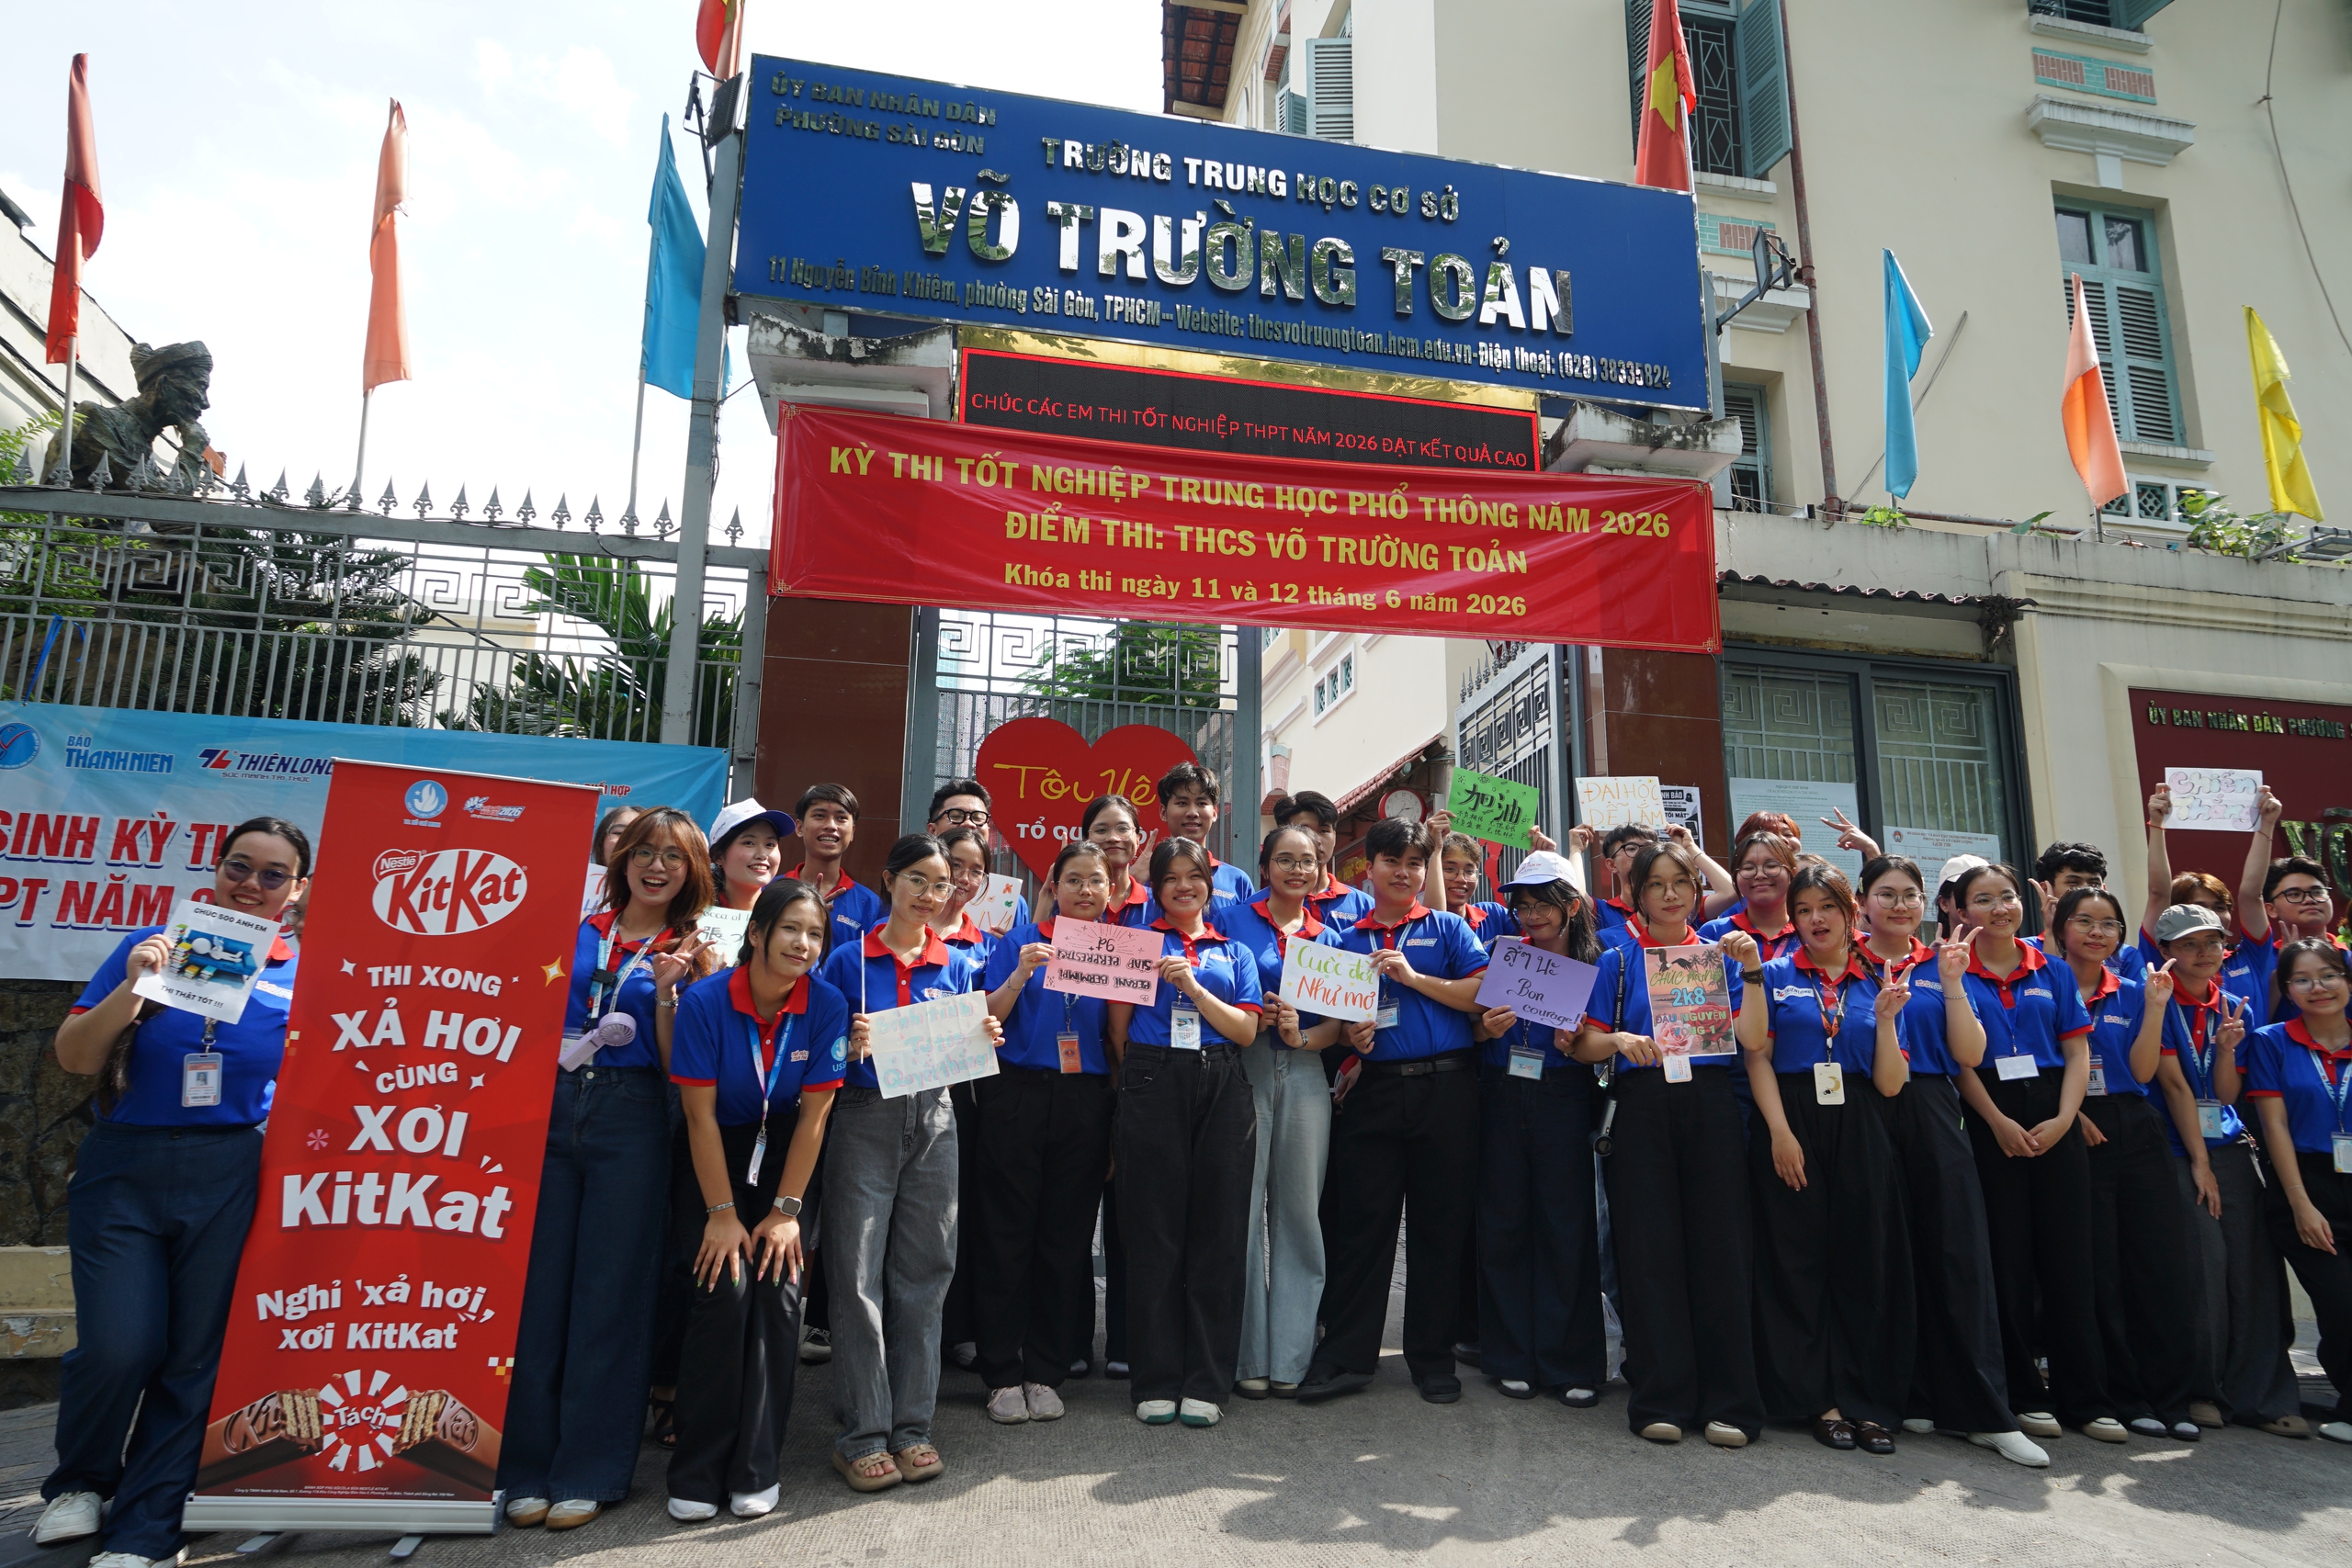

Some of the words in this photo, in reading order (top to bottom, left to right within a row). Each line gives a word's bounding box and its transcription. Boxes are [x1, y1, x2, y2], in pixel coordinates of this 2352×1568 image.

[771, 70, 806, 97] ỦY
[811, 82, 864, 107] BAN
[869, 92, 940, 118] NHÂN
[945, 100, 997, 127] DÂN
[775, 107, 880, 141] PHƯỜNG
[886, 121, 928, 147] SÀI
[933, 129, 985, 155] GÒN
[1042, 137, 1171, 182] TRƯỜNG
[1183, 157, 1287, 198] TRUNG
[1296, 173, 1360, 211] HỌC
[1369, 183, 1410, 215] CƠ
[1420, 184, 1460, 221] SỞ
[910, 168, 1020, 262] VÕ
[1046, 198, 1356, 307] TRƯỜNG
[1381, 236, 1575, 336] TOẢN
[769, 254, 786, 284] 11
[790, 257, 855, 292] Nguyễn
[860, 265, 898, 296] Bỉnh
[902, 271, 961, 307] Khiêm,
[965, 278, 1028, 314] phường
[1032, 286, 1058, 315] Sài
[1064, 289, 1100, 322] Gòn,
[1514, 346, 1556, 379] thoại:
[1558, 351, 1599, 382] (028)
[971, 392, 1023, 412] CHÚC
[1027, 397, 1063, 417] CÁC
[1068, 404, 1092, 421] EM
[1098, 407, 1126, 424] THI
[1172, 413, 1240, 439] NGHIỆP
[1243, 423, 1289, 441] THPT
[1293, 426, 1331, 446] NĂM
[1335, 432, 1378, 451] 2026
[1382, 436, 1417, 457] ĐẠT
[1494, 450, 1527, 468] CAO
[830, 442, 876, 476] KỲ
[888, 452, 943, 482] THI
[955, 451, 1019, 490] TỐT
[1032, 465, 1150, 503] NGHIỆP
[1159, 475, 1264, 510] TRUNG
[1276, 486, 1338, 518] HỌC
[1349, 481, 1408, 520] PHỔ
[1418, 493, 1519, 529] THÔNG
[1528, 501, 1590, 534] NĂM
[1600, 510, 1670, 538] 2026
[1004, 501, 1091, 546] ĐIỂM
[1101, 519, 1163, 550] THI:
[1174, 525, 1257, 558] THCS
[1266, 527, 1307, 561] VÕ
[1317, 534, 1438, 570] TRƯỜNG
[1447, 538, 1528, 574] TOẢN
[1004, 562, 1070, 589] Khóa
[1079, 569, 1112, 592] thi
[1121, 574, 1181, 600] ngày
[1191, 577, 1222, 600] 11
[1230, 581, 1259, 603] và
[1269, 582, 1300, 604] 12
[1307, 585, 1377, 611] tháng
[1385, 589, 1401, 609] 6
[1410, 592, 1458, 614] năm
[1466, 594, 1527, 616] 2026
[2147, 699, 2167, 726] ỦY
[2172, 707, 2203, 728] BAN
[2207, 708, 2249, 732] NHÂN
[2253, 710, 2284, 734] DÂN
[2287, 716, 2346, 739] PHƯỜNG
[67, 734, 92, 748] BÁO
[610, 784, 631, 798] HỢP
[1623, 783, 1659, 802] HỌC
[2168, 771, 2258, 795] Chiến
[1458, 783, 1523, 825] 加油
[110, 811, 177, 863] KỲ
[1016, 816, 1046, 839] TỔ
[380, 855, 417, 871] Nestlé
[55, 874, 175, 927] NĂM
[387, 850, 522, 934] KitKat
[194, 907, 218, 919] CHÚC
[219, 913, 234, 924] 500
[236, 918, 254, 929] ANH
[254, 922, 267, 933] EM
[1297, 945, 1343, 979] Cuộc
[1649, 970, 1685, 987] CHÚC
[161, 985, 175, 995] THI
[175, 988, 196, 1002] THẬT
[197, 994, 213, 1006] TỐT
[368, 965, 412, 987] THI
[419, 965, 503, 997] XONG
[1296, 975, 1342, 1007] Như
[1344, 991, 1376, 1010] mơ
[1506, 977, 1545, 1005] Bon
[1670, 987, 1706, 1007] 2k8
[331, 997, 406, 1052] XẢ
[423, 1010, 522, 1063] HƠI
[1522, 1003, 1581, 1027] courage!
[1655, 1012, 1678, 1024] ĐẬU
[1680, 1010, 1727, 1022] NGUYỆN
[1709, 1025, 1716, 1034] 1
[376, 1062, 458, 1093] CÙNG
[347, 1104, 469, 1157] XƠI
[281, 1170, 513, 1239] KitKat
[255, 1280, 342, 1322] Nghỉ
[277, 1322, 335, 1350] xơi
[346, 1322, 458, 1350] KitKat
[334, 1405, 388, 1430] Tách
